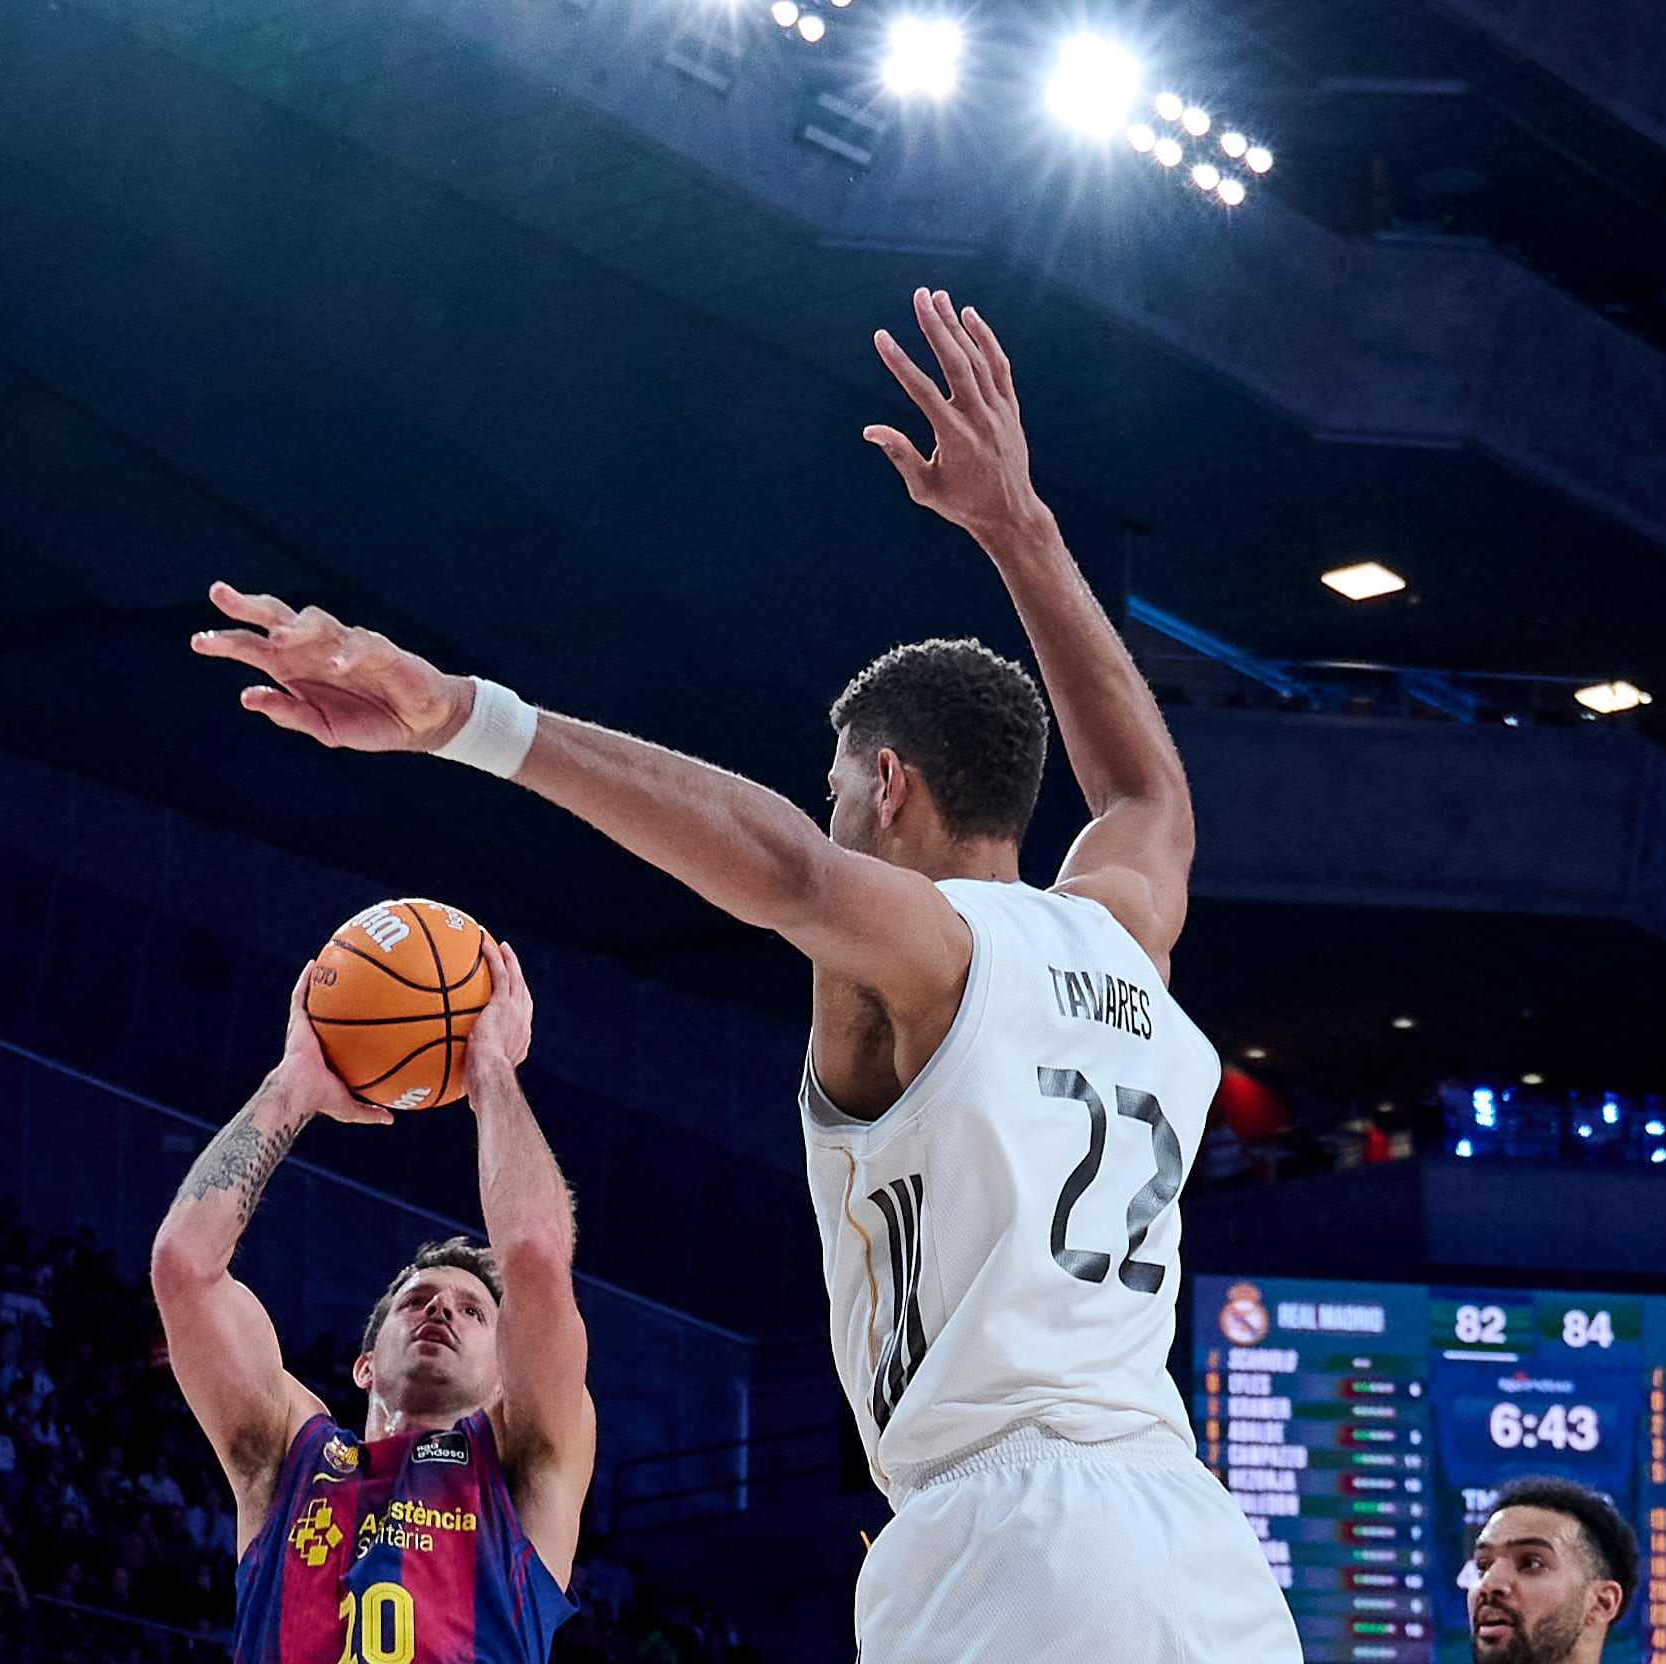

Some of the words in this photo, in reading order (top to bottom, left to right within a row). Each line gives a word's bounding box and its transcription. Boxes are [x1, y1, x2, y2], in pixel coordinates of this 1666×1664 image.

[1048, 964, 1153, 1040] TAVARES
[1037, 1065, 1183, 1294] 22
[1455, 1304, 1507, 1344] 82
[1562, 1309, 1615, 1349] 84
[1490, 1401, 1600, 1452] 6:43
[359, 1500, 477, 1536] Astència
